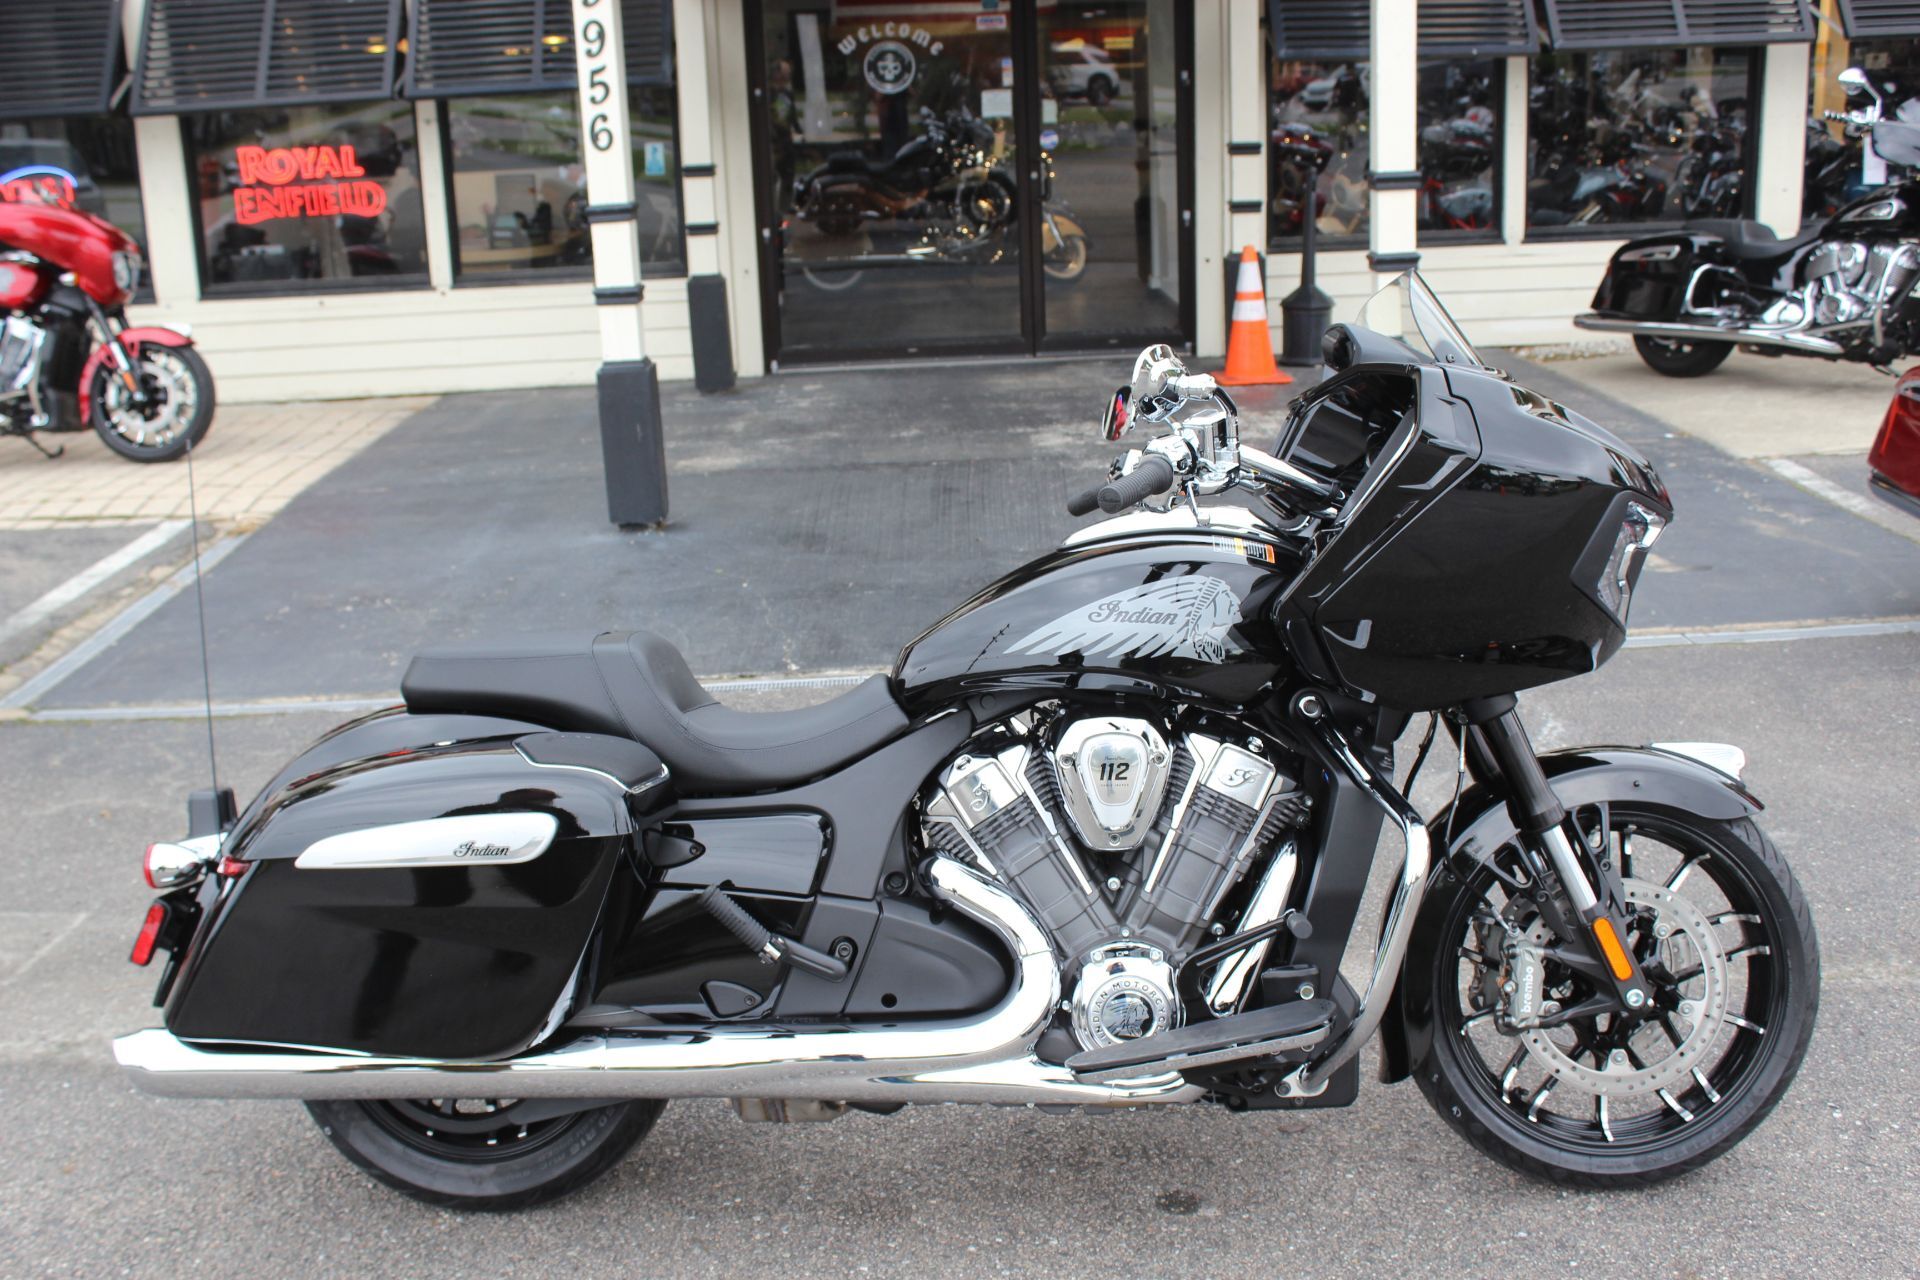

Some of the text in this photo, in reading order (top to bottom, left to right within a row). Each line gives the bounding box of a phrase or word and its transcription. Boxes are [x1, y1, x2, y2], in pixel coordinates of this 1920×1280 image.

[582, 0, 613, 151] 956
[236, 145, 365, 185] ROYAL
[234, 180, 387, 225] ENFIELD
[1087, 600, 1178, 625] Indian
[1100, 762, 1130, 781] 112
[453, 841, 510, 857] Indian
[1092, 980, 1167, 1040] INDIAN MOTORCYCL
[1521, 966, 1534, 1013] brembo
